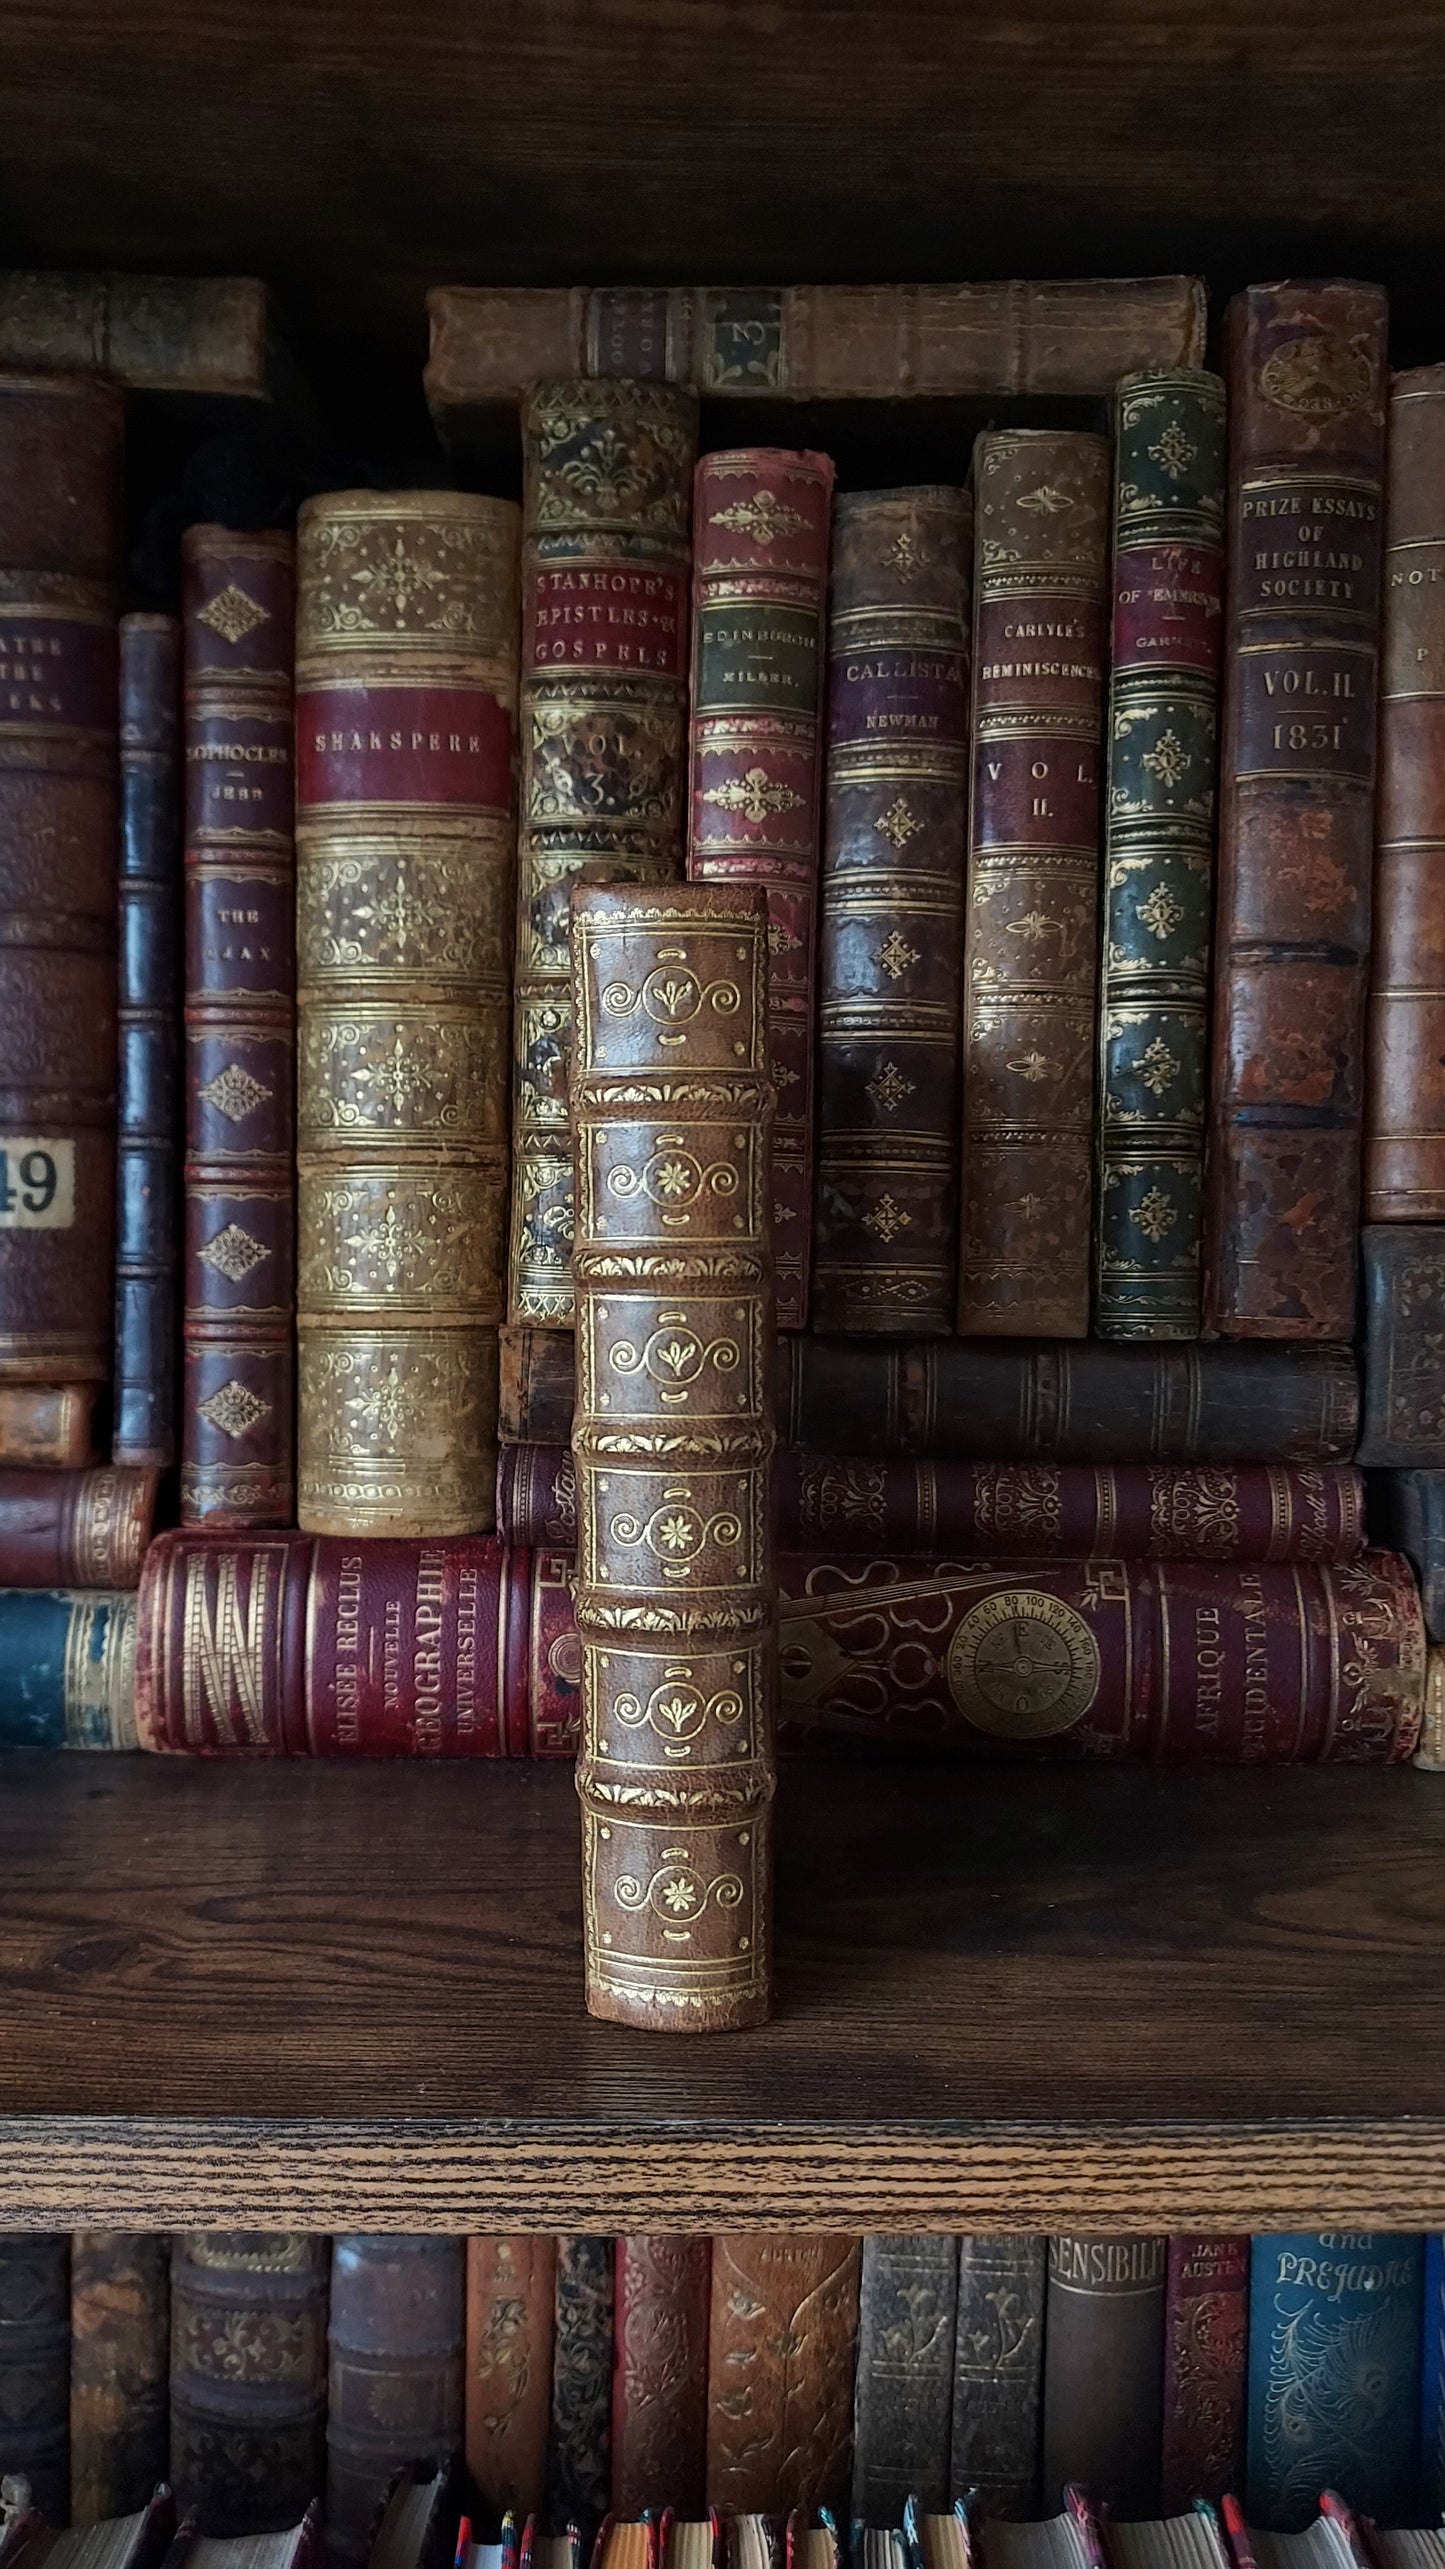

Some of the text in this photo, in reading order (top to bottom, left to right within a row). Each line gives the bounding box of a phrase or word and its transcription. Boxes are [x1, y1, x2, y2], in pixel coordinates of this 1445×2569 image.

[1242, 497, 1377, 522] PRIZE ESSAYS
[1298, 525, 1325, 543] OF
[1254, 550, 1364, 573] HIGHLAND
[1118, 589, 1142, 605] OF
[1259, 578, 1353, 600] SOCIETY
[1003, 618, 1087, 640] CARLYLE'S
[535, 640, 669, 667] GOSPELS
[846, 661, 961, 682] CALLISTA
[865, 713, 939, 729] NEWMAN
[314, 729, 481, 753] SHAKSPERE
[1271, 724, 1343, 751] 1831
[217, 908, 260, 925] THE
[1004, 1595, 1019, 1607] 80
[1026, 1595, 1045, 1608] 100
[327, 1555, 363, 1745] ÉLISÉE RECLUS
[383, 1599, 401, 1709] NOUVELLE
[406, 1549, 447, 1751] GÉOGRAPHIE
[455, 1567, 478, 1736] UNIVERSELLE
[1194, 1606, 1226, 1738] AFRIQUE
[1190, 2243, 1240, 2259] JANE
[1181, 2257, 1247, 2279] AUSTEN
